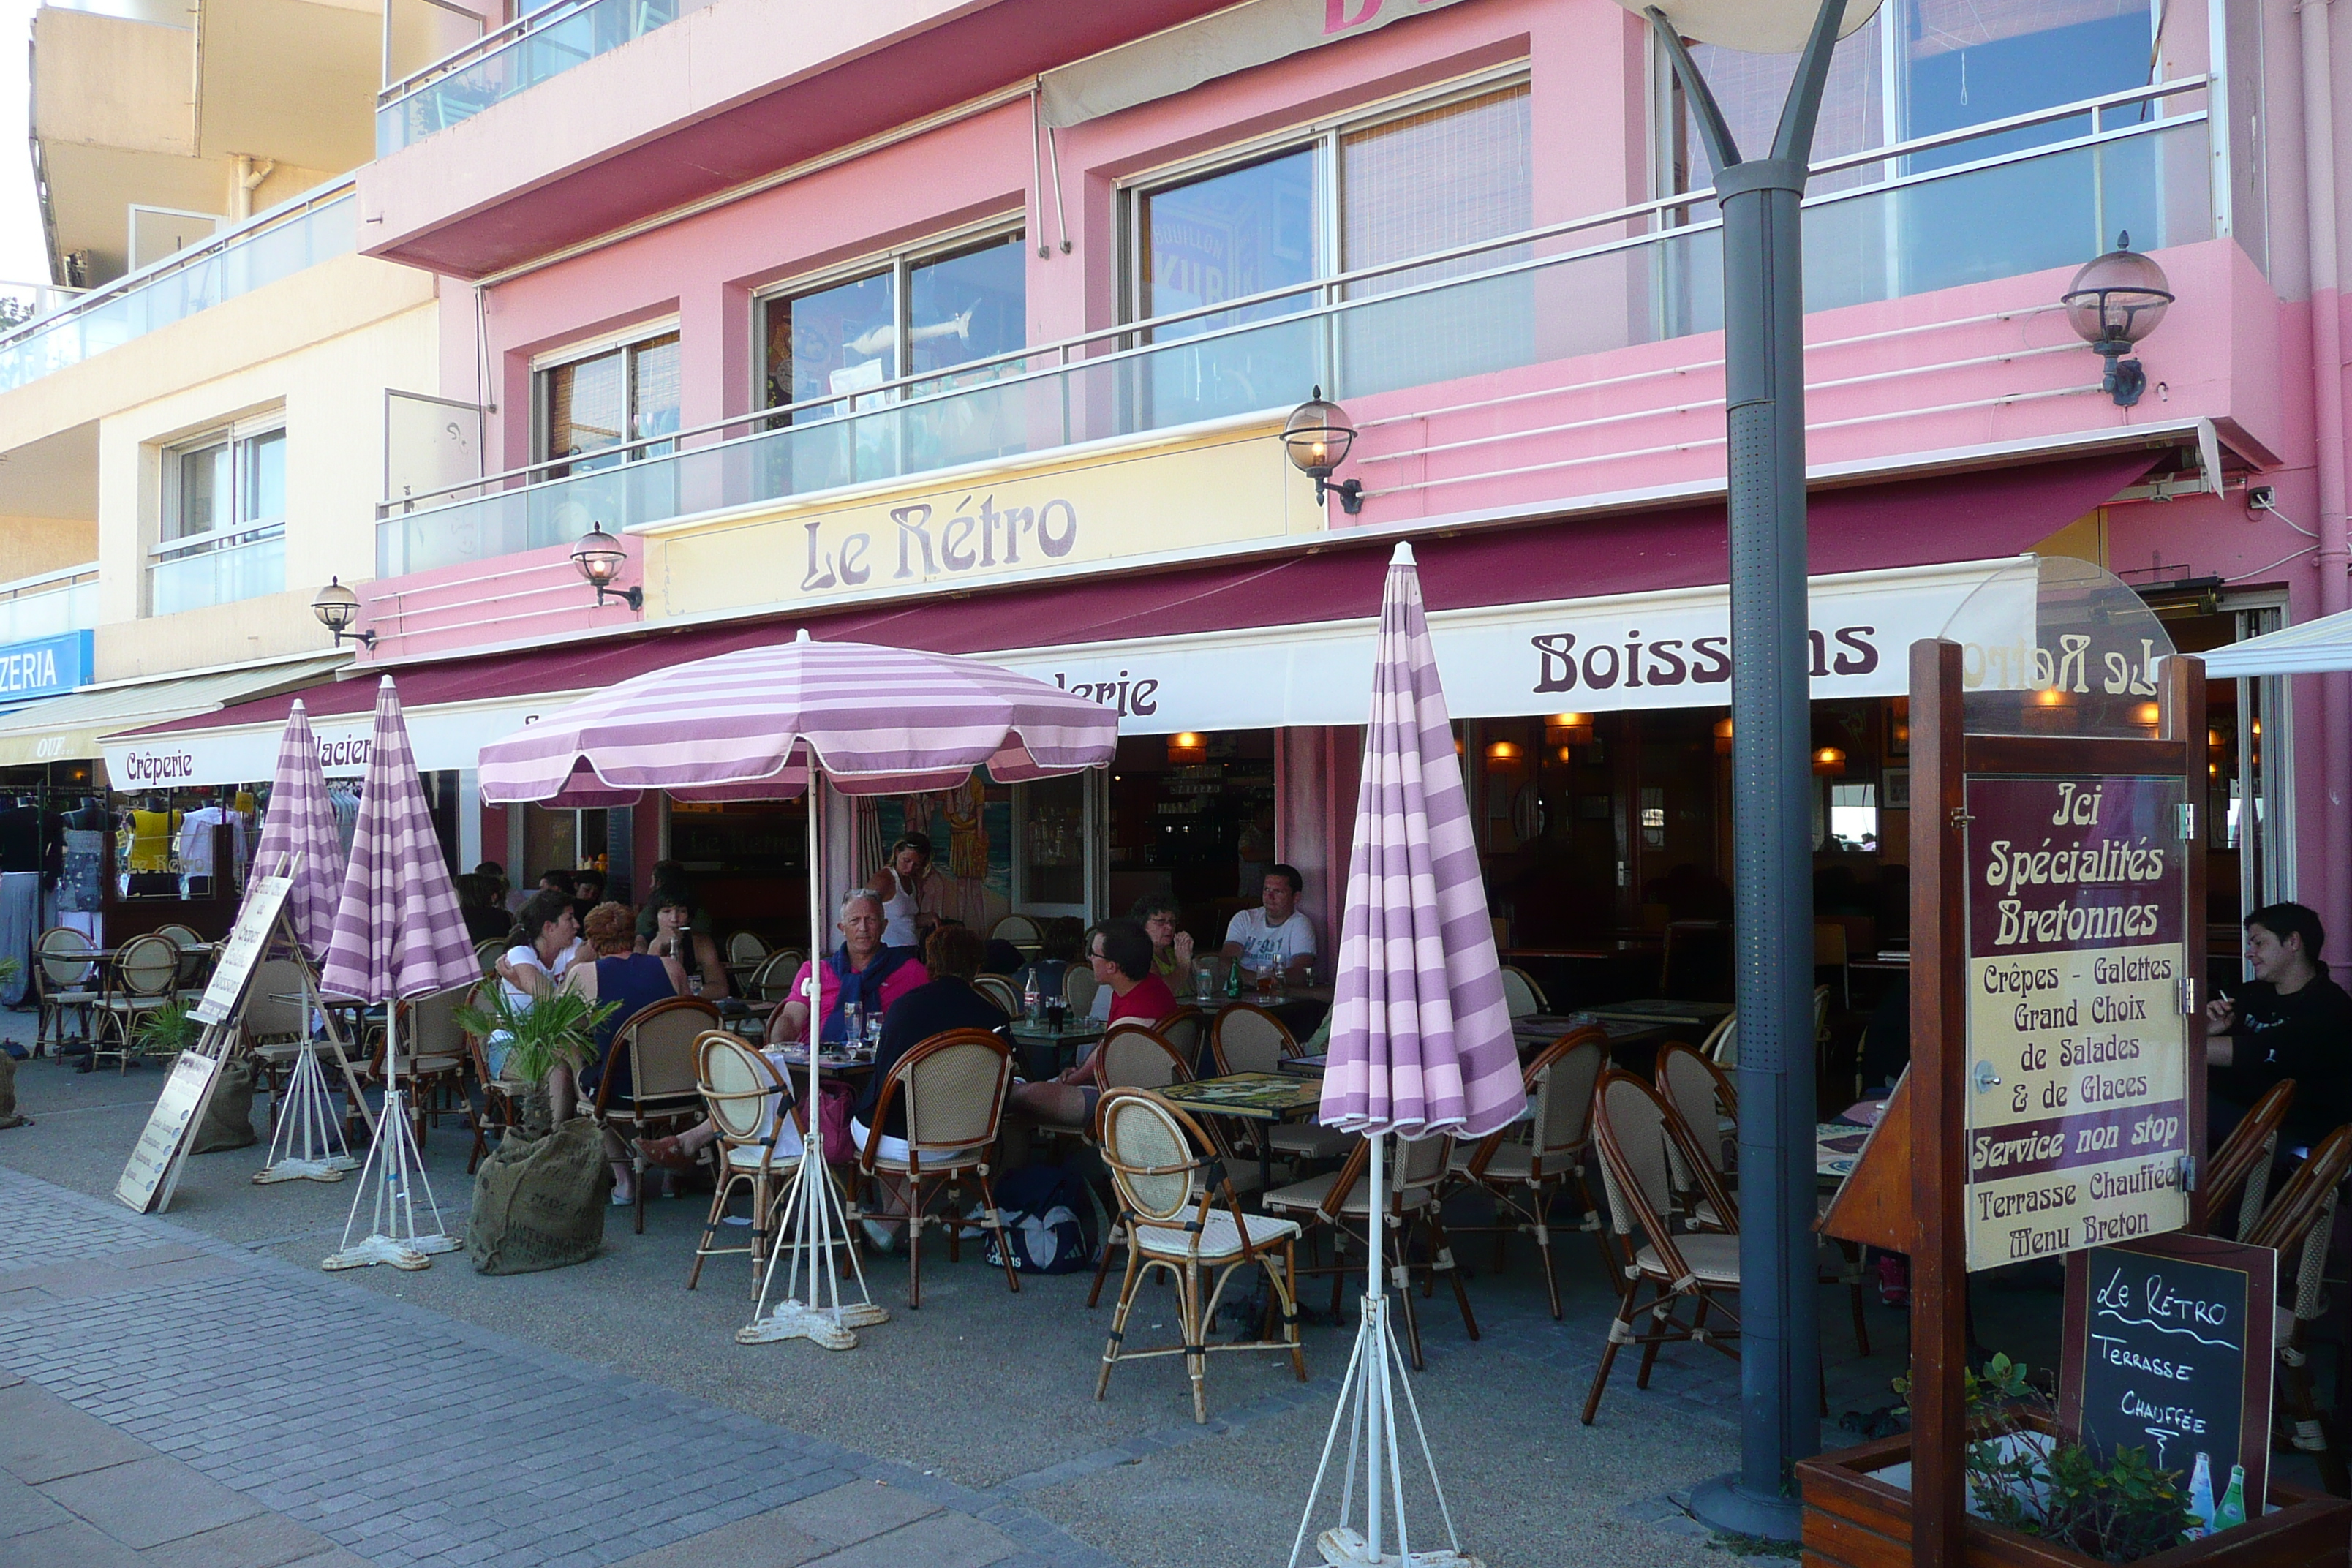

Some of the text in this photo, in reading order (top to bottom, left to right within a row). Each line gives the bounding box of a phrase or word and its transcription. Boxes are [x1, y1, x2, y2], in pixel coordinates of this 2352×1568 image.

[800, 494, 1077, 592] Le Rétro
[1531, 625, 1879, 693] Boissns
[127, 749, 192, 785] Crêperie
[315, 734, 372, 767] lacier
[2052, 783, 2102, 826] Ici
[1986, 837, 2164, 896] Spécialités
[1994, 900, 2158, 945] Bretonnes
[1983, 962, 2059, 998] Crêpes
[2094, 956, 2171, 985] Galettes
[2014, 995, 2146, 1031] Grand Choix
[2021, 1034, 2139, 1071] de Salades
[2012, 1074, 2147, 1113] & de Glaces
[1973, 1113, 2179, 1170] Service non stop
[1978, 1161, 2176, 1221] Terrasse Chauffée
[2010, 1210, 2149, 1259] Menu Breton
[2097, 1267, 2129, 1308] Le
[2121, 1390, 2207, 1434] CHAUFFÉE
